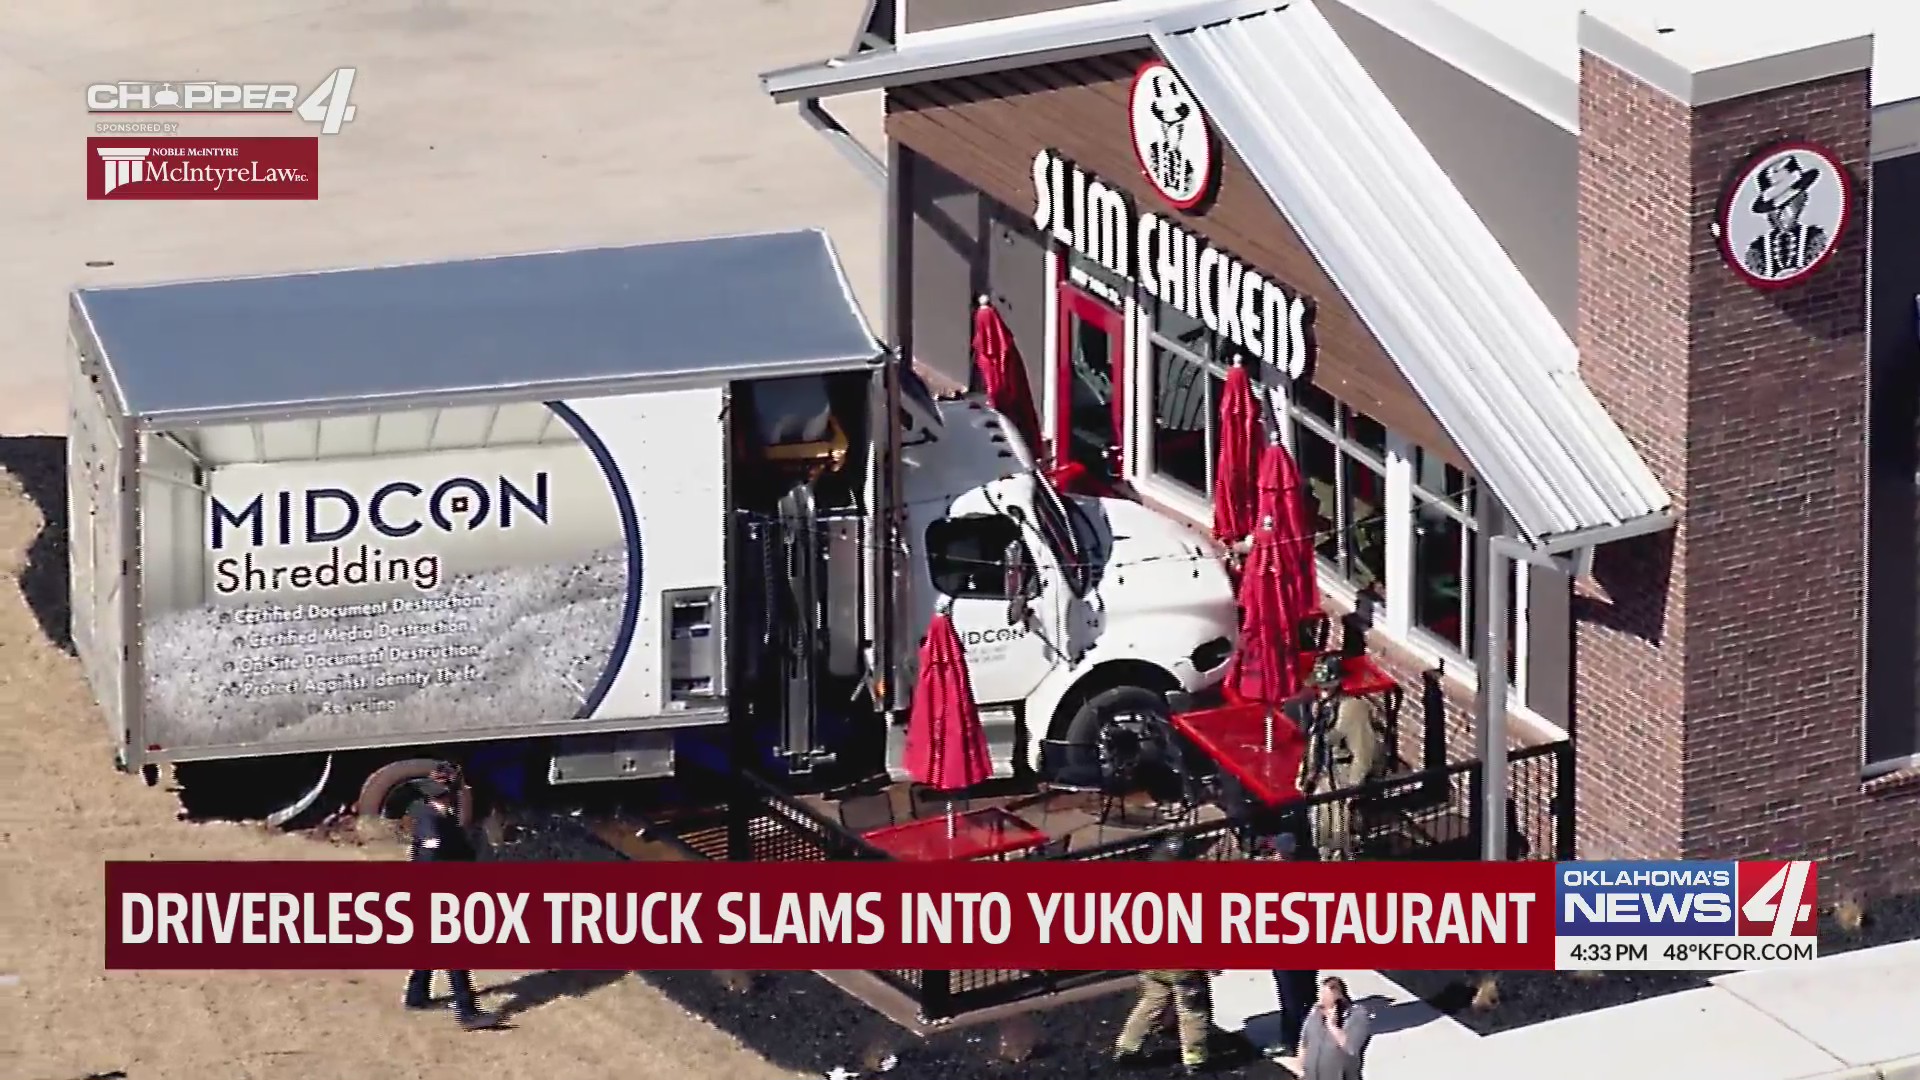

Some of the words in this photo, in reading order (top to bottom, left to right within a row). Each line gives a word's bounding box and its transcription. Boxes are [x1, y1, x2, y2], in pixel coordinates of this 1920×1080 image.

[210, 472, 549, 550] MIDCON
[215, 544, 439, 592] Shredding
[233, 603, 304, 625] Certified
[307, 600, 387, 619] Document
[391, 594, 483, 613] Destruction
[249, 628, 318, 648] Certified
[323, 623, 374, 642] Media
[378, 619, 469, 639] Destruction
[961, 628, 1025, 645] IDCON
[303, 649, 385, 669] Document
[388, 642, 479, 662] Destruction
[242, 679, 299, 697] Protect
[304, 675, 368, 696] Against
[370, 670, 431, 690] Identity
[435, 665, 477, 684] Theft
